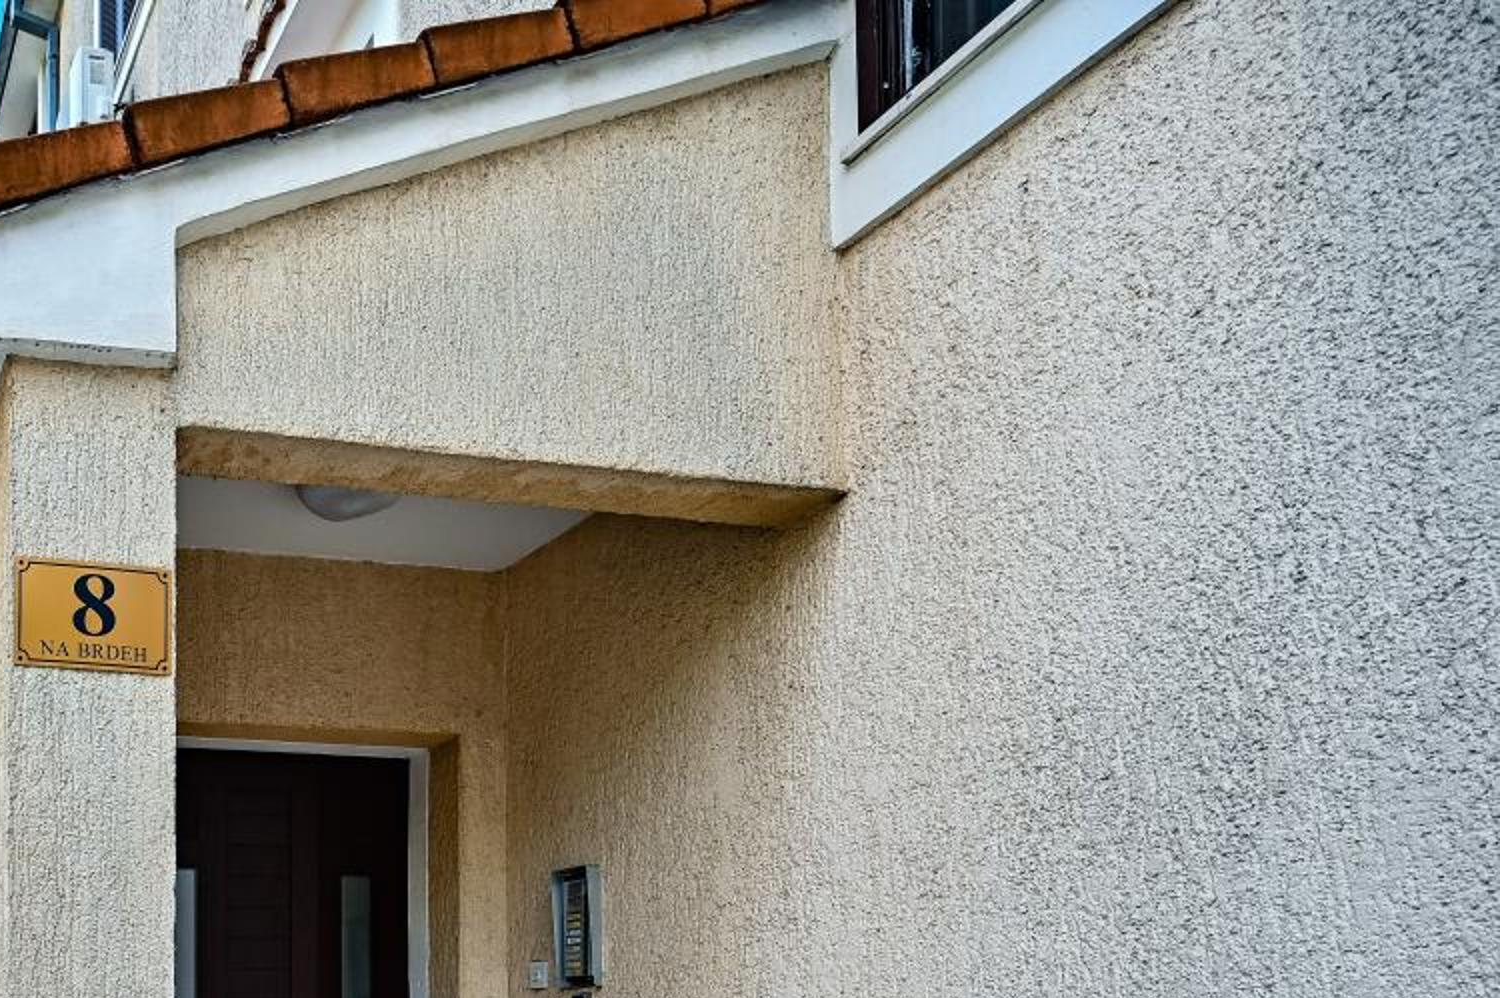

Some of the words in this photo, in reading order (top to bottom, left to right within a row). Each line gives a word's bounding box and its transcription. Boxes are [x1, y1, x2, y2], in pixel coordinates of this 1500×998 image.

[72, 573, 116, 637] 8
[40, 640, 69, 657] NA
[78, 643, 147, 663] BRDEH
